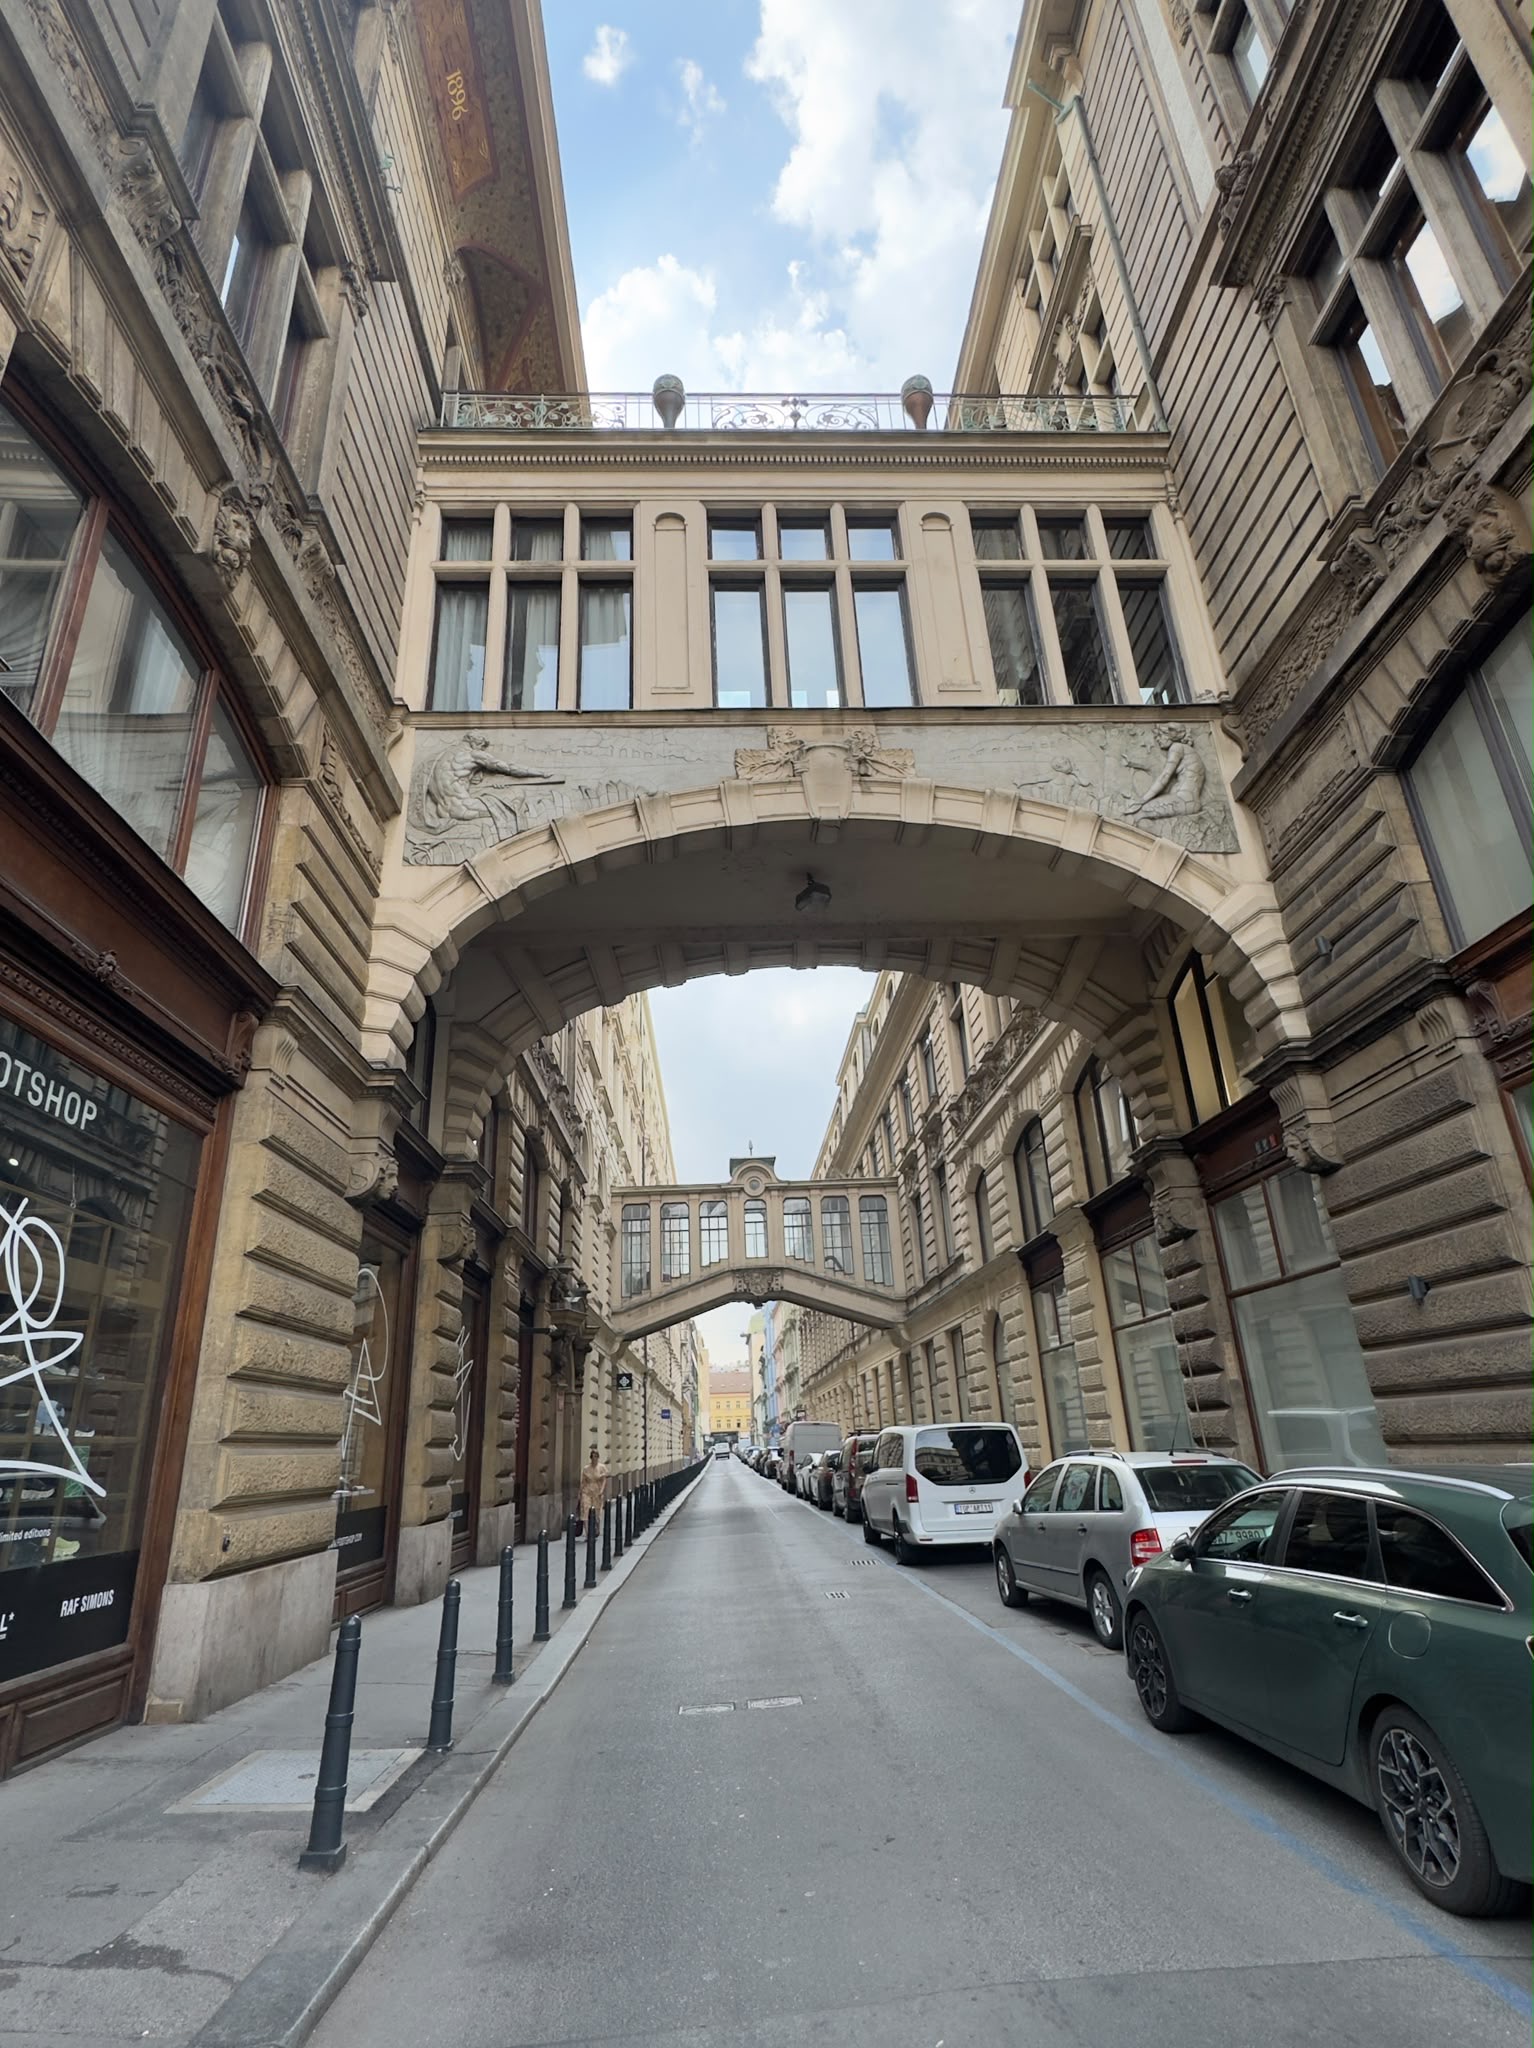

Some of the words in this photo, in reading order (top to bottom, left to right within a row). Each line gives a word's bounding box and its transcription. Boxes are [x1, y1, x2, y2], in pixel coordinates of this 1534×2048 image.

[446, 67, 469, 121] 1896
[0, 1051, 97, 1130] OTSHOP
[24, 1528, 51, 1540] editions
[60, 1597, 80, 1617] RAF
[80, 1589, 114, 1612] SIMONS
